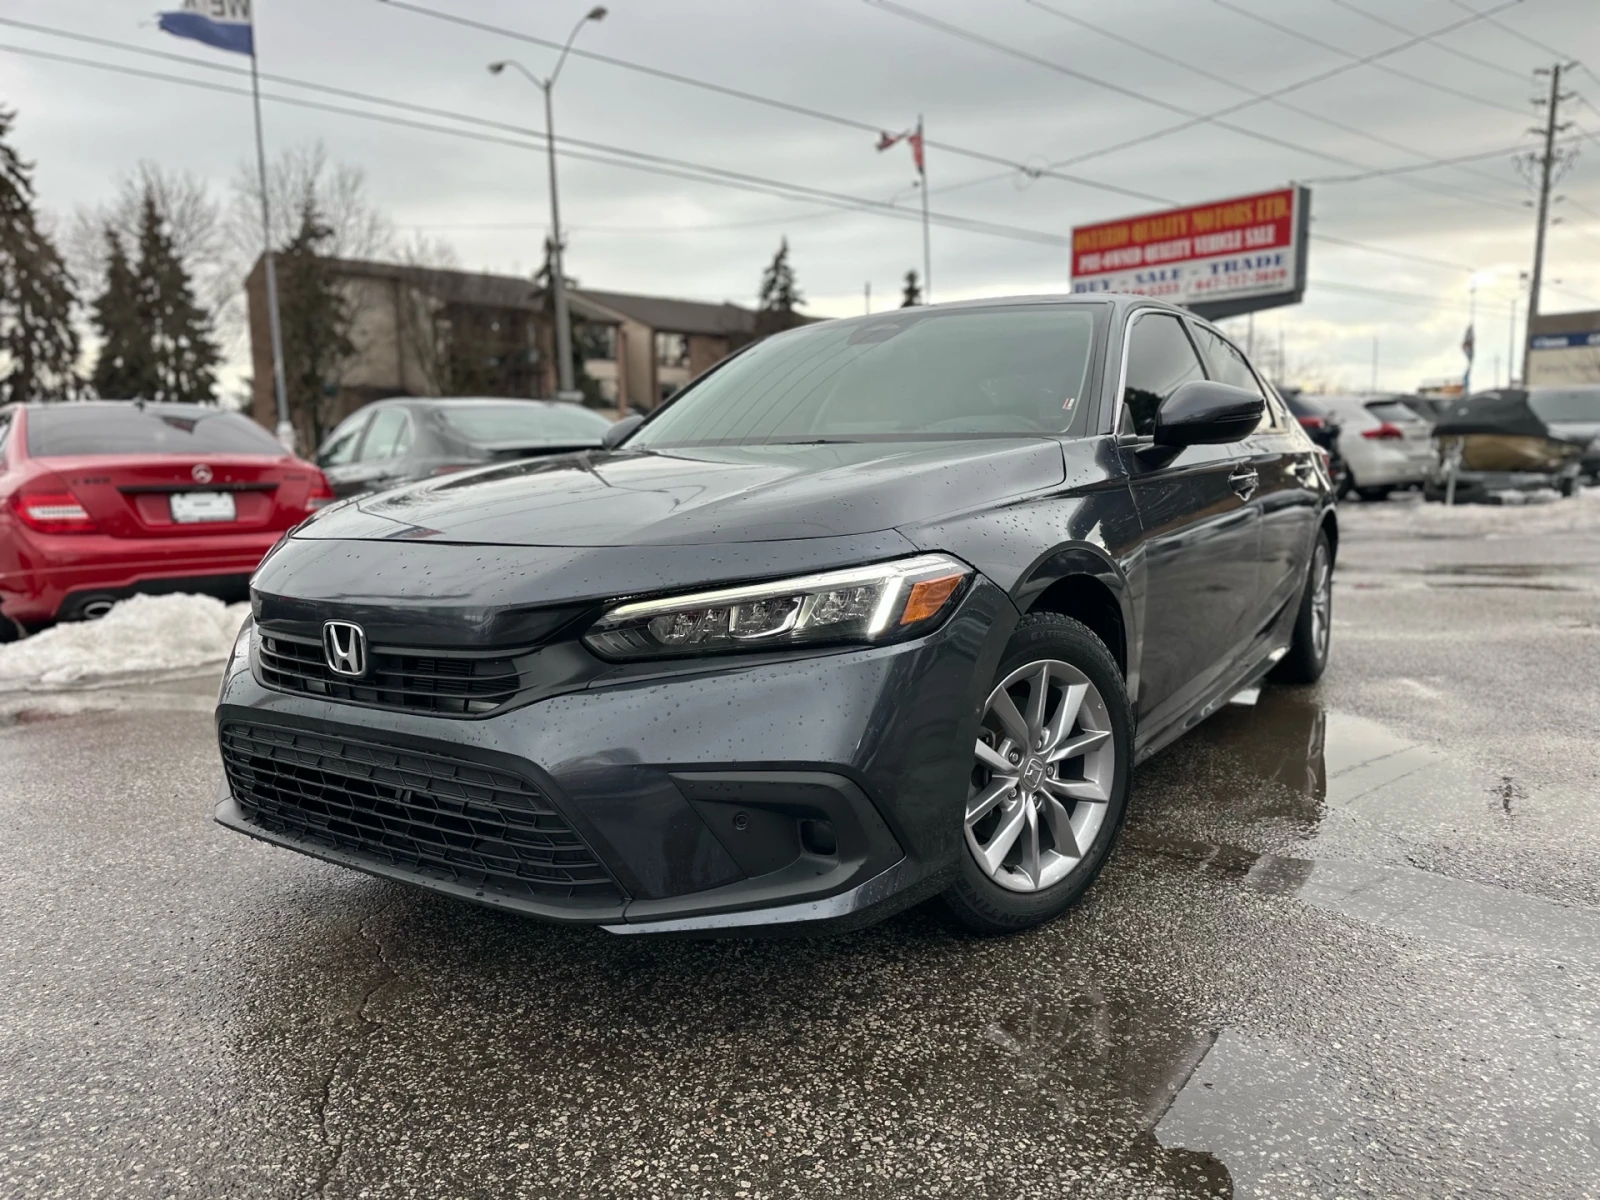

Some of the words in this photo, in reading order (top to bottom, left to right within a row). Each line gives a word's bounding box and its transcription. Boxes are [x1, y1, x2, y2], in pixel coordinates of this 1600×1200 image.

[1131, 214, 1187, 243] QUALITY
[1192, 203, 1254, 233] MOTORS
[1245, 223, 1276, 245] SALE
[1075, 279, 1111, 293] BUY
[1134, 268, 1182, 285] SALE
[1209, 253, 1287, 275] TRADE
